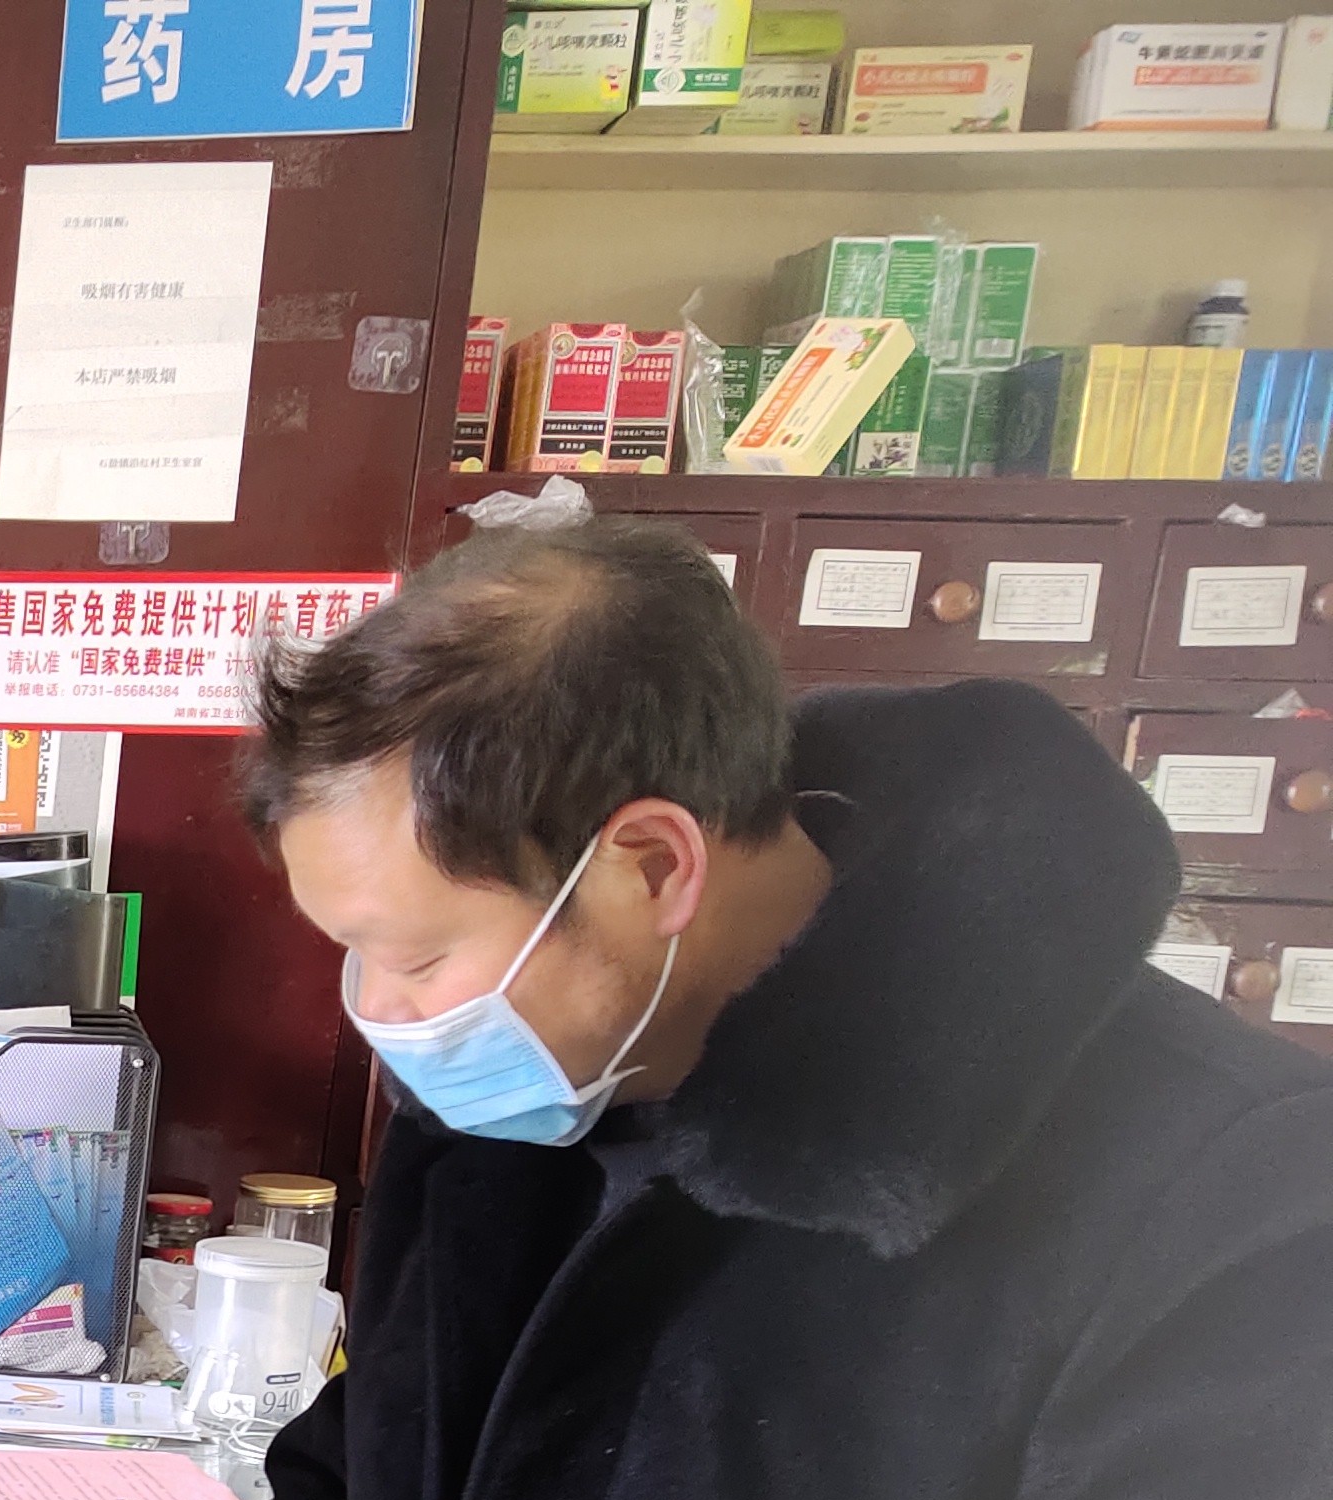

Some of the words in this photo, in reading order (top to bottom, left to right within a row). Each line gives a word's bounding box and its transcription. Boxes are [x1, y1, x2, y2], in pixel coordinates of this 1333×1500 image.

[81, 281, 185, 300] 吸烟有害健康
[74, 367, 177, 386] 本店严禁吸烟
[263, 1388, 301, 1414] 940
